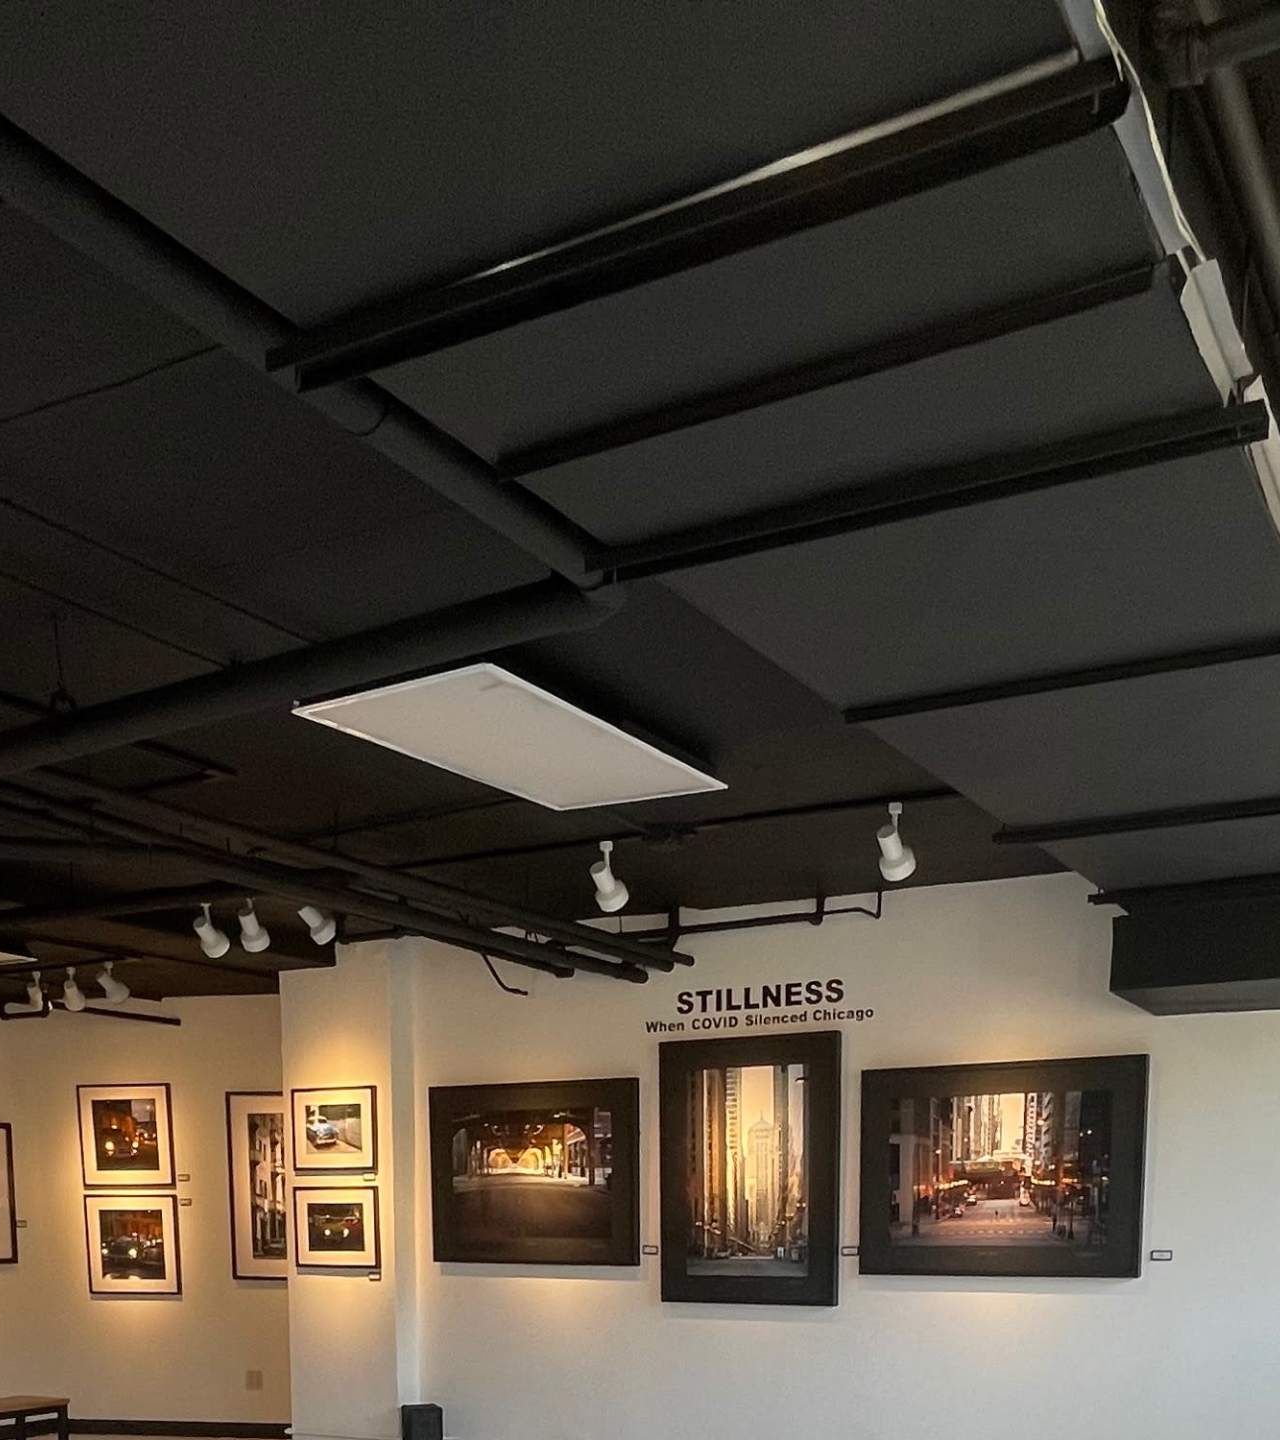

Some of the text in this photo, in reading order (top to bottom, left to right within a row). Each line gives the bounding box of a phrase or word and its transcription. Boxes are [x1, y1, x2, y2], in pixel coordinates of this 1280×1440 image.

[676, 978, 844, 1015] STILLNESS
[645, 1007, 874, 1033] When COVID Silenced Chicago
